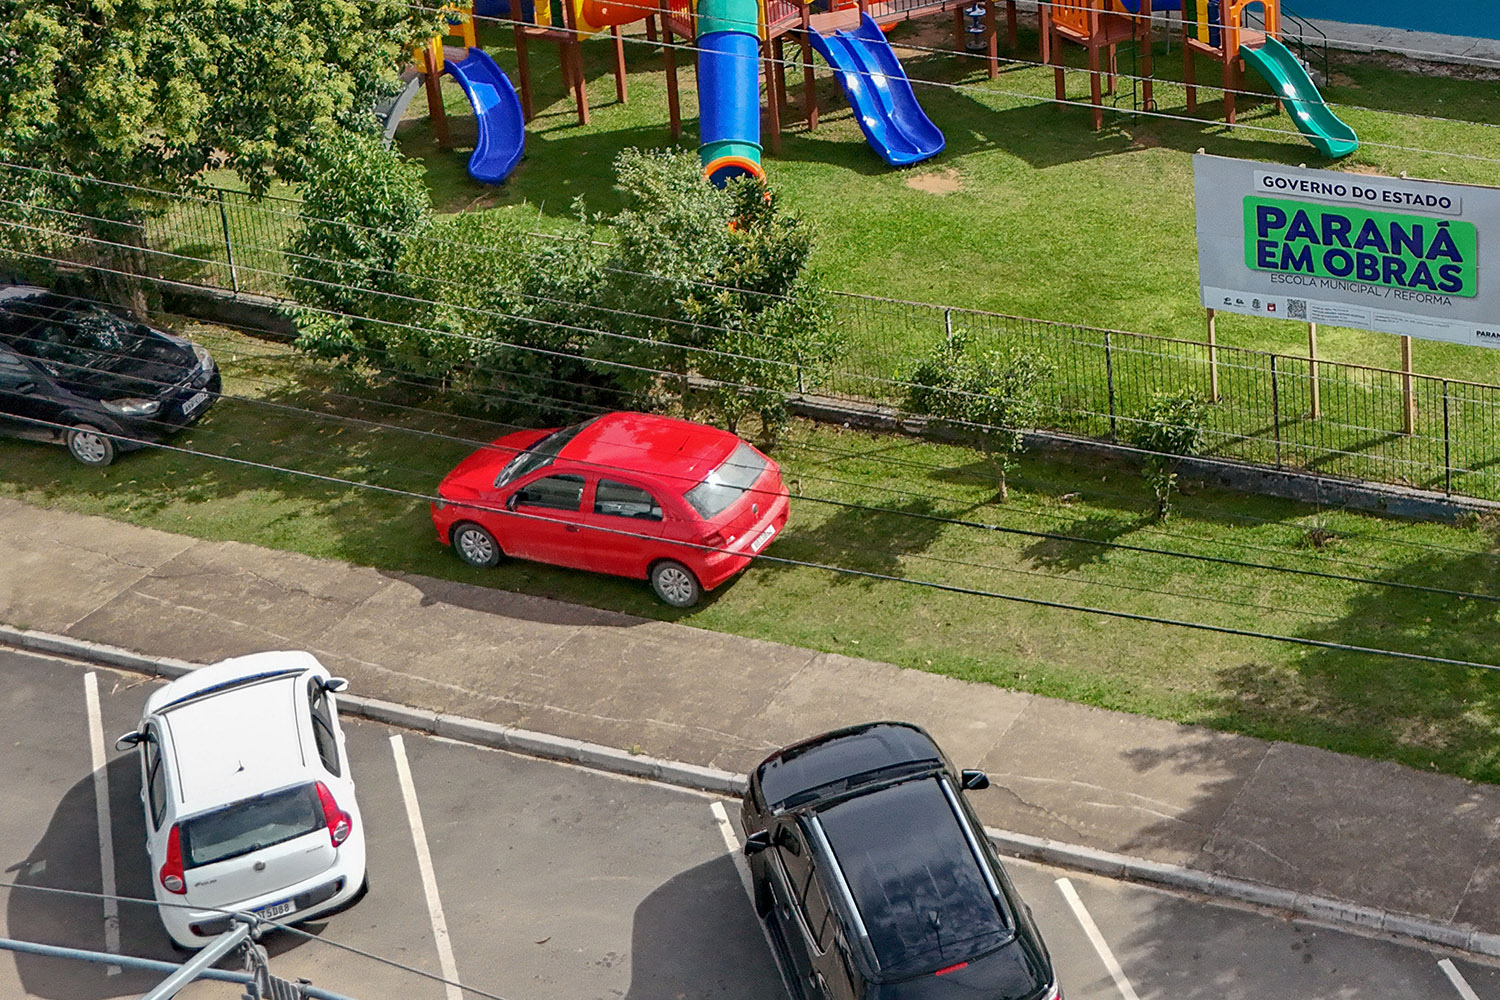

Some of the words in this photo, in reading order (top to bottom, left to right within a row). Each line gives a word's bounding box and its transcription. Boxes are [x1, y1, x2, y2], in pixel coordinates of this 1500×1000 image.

[1263, 176, 1347, 196] GOVERNO
[1352, 186, 1377, 200] DO
[1383, 190, 1452, 209] ESTADO
[1256, 205, 1464, 263] PARANÁ
[1256, 239, 1315, 273] EM
[1322, 248, 1464, 293] OBRAS
[1270, 273, 1317, 288] ESCOLA
[1320, 279, 1382, 297] MUNICIPAL
[1384, 288, 1391, 299] /
[1394, 290, 1452, 306] REFORMA
